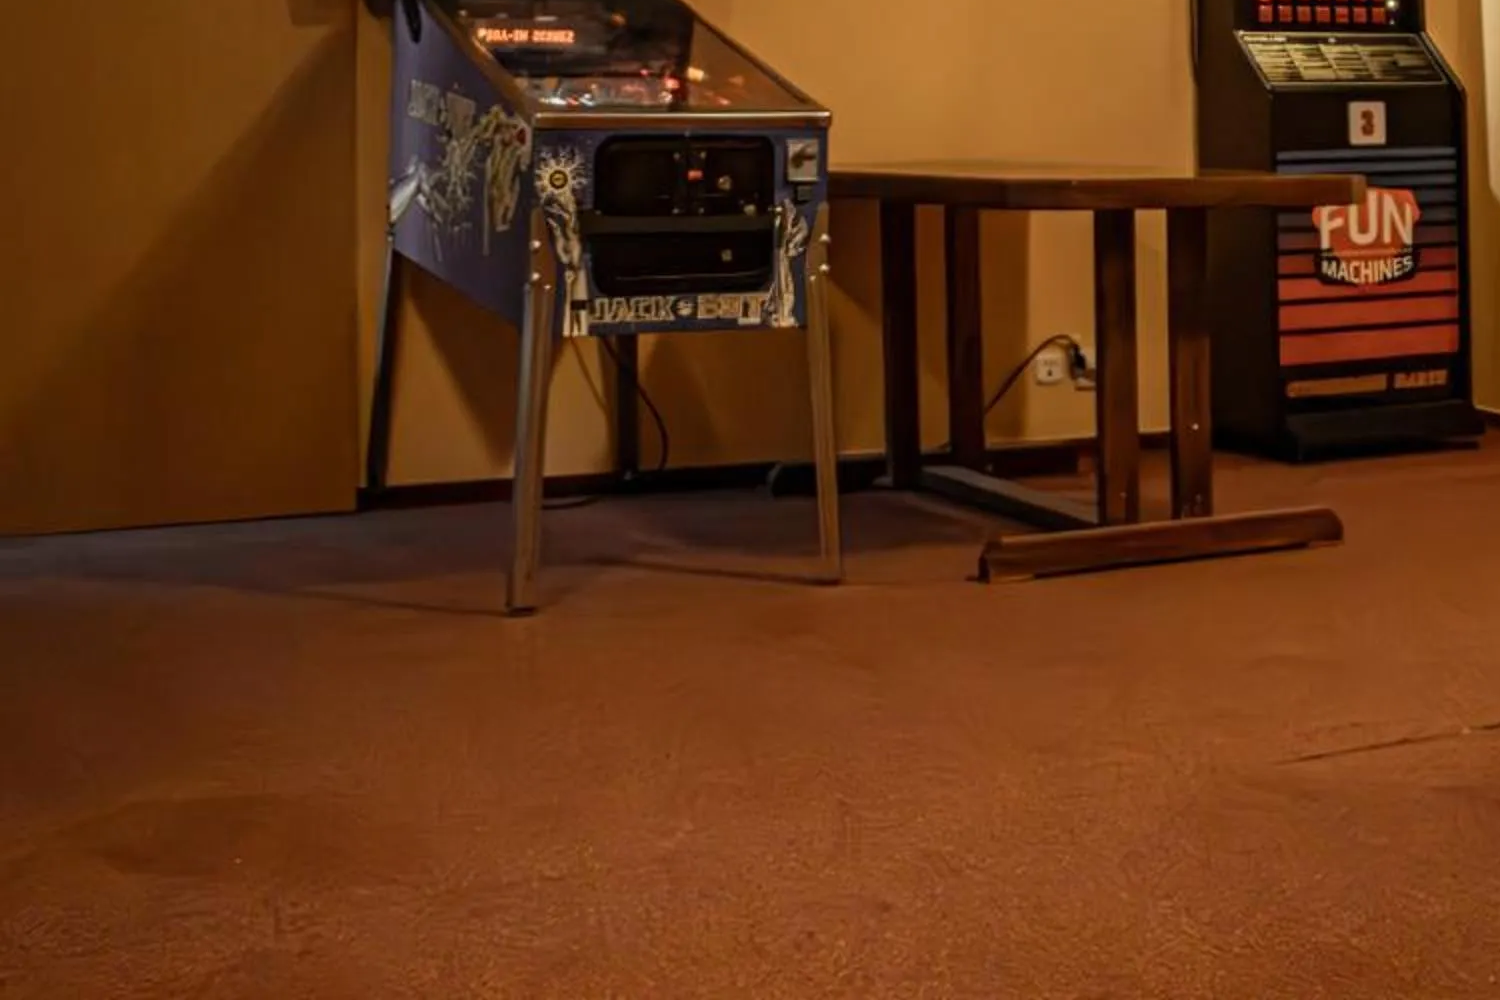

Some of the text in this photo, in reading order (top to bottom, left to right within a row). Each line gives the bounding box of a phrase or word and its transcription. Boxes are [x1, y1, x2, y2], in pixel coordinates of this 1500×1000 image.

[1361, 109, 1375, 137] 3
[1318, 187, 1414, 250] FUN
[1320, 254, 1413, 285] MACHINES
